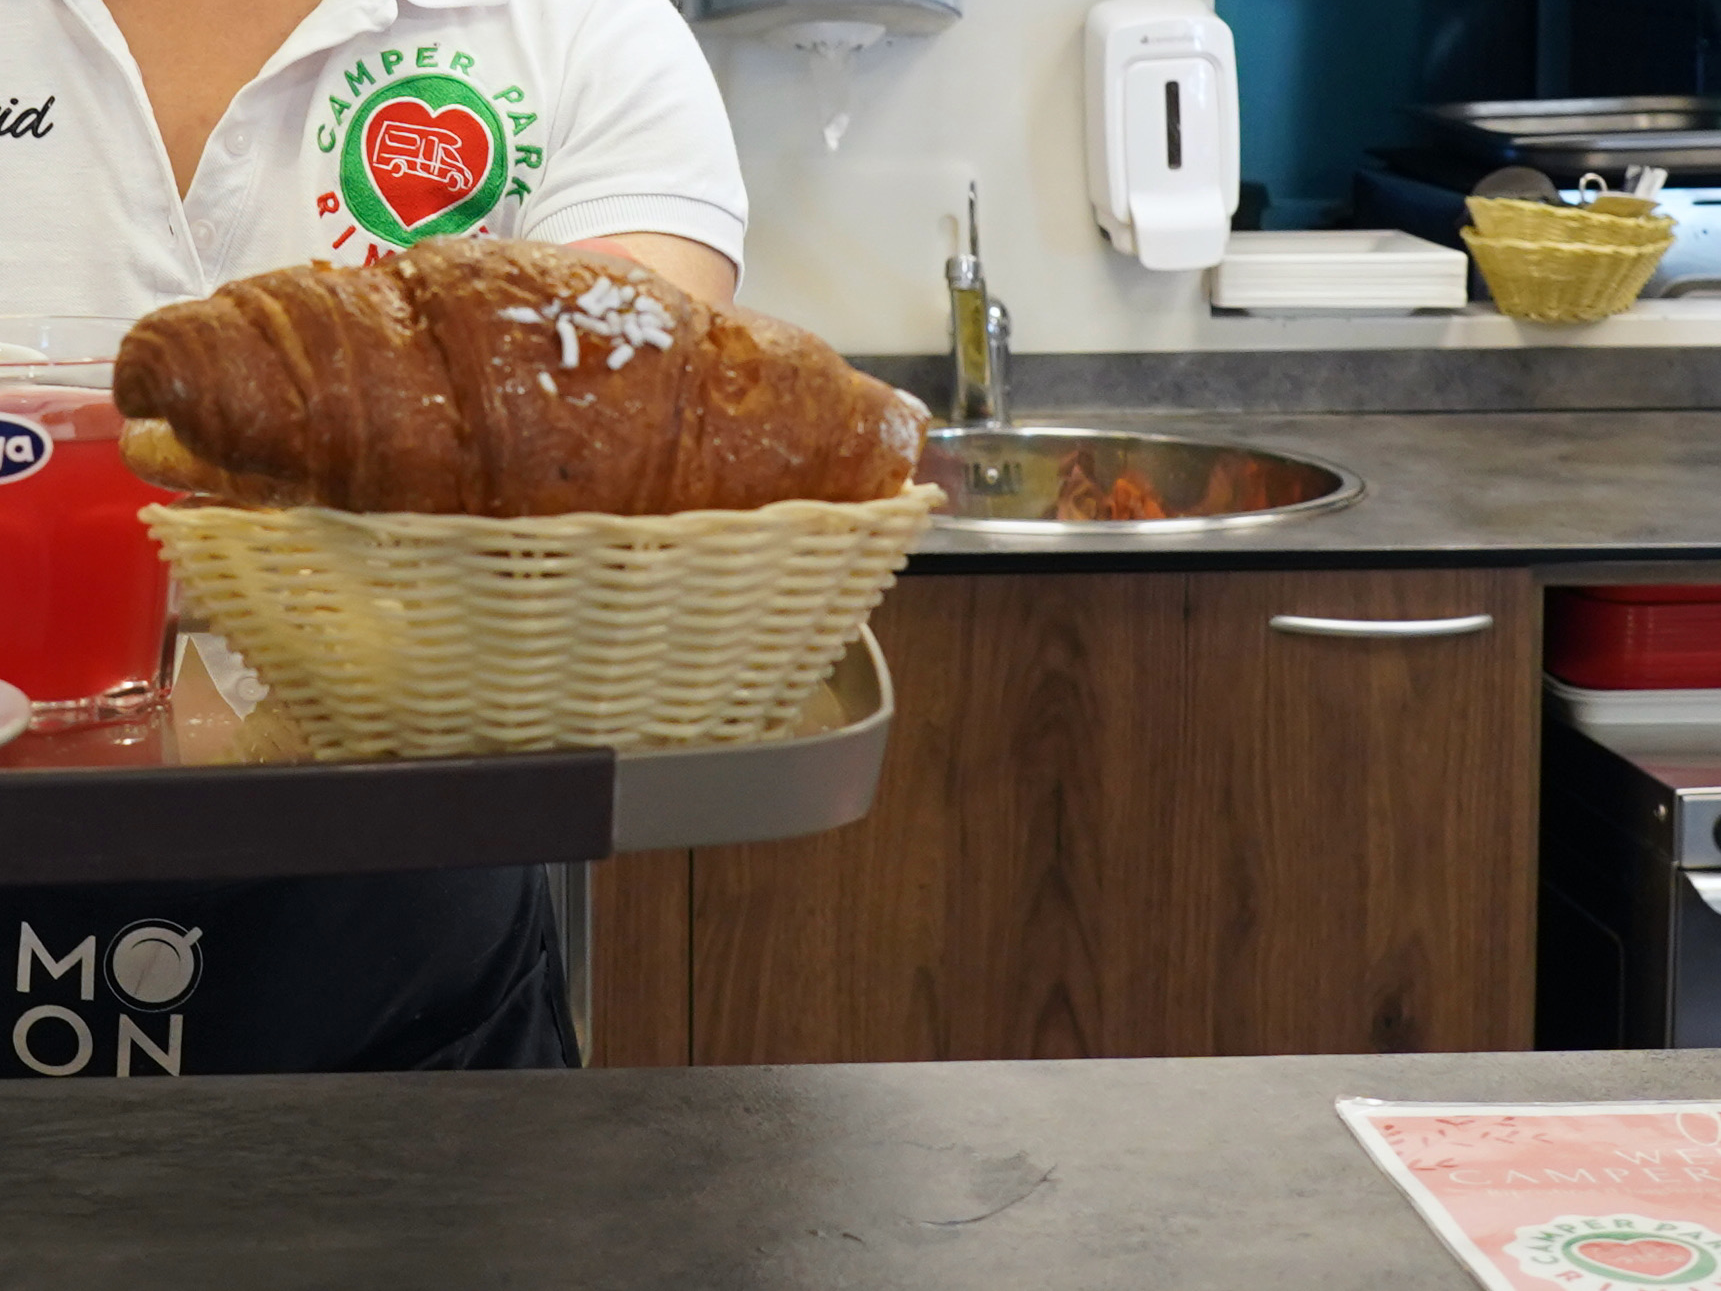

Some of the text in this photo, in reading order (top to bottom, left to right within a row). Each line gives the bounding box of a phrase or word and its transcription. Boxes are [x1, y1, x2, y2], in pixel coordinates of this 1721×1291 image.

[317, 46, 543, 206] CAMPER PARK
[1448, 1166, 1721, 1186] CAMPER
